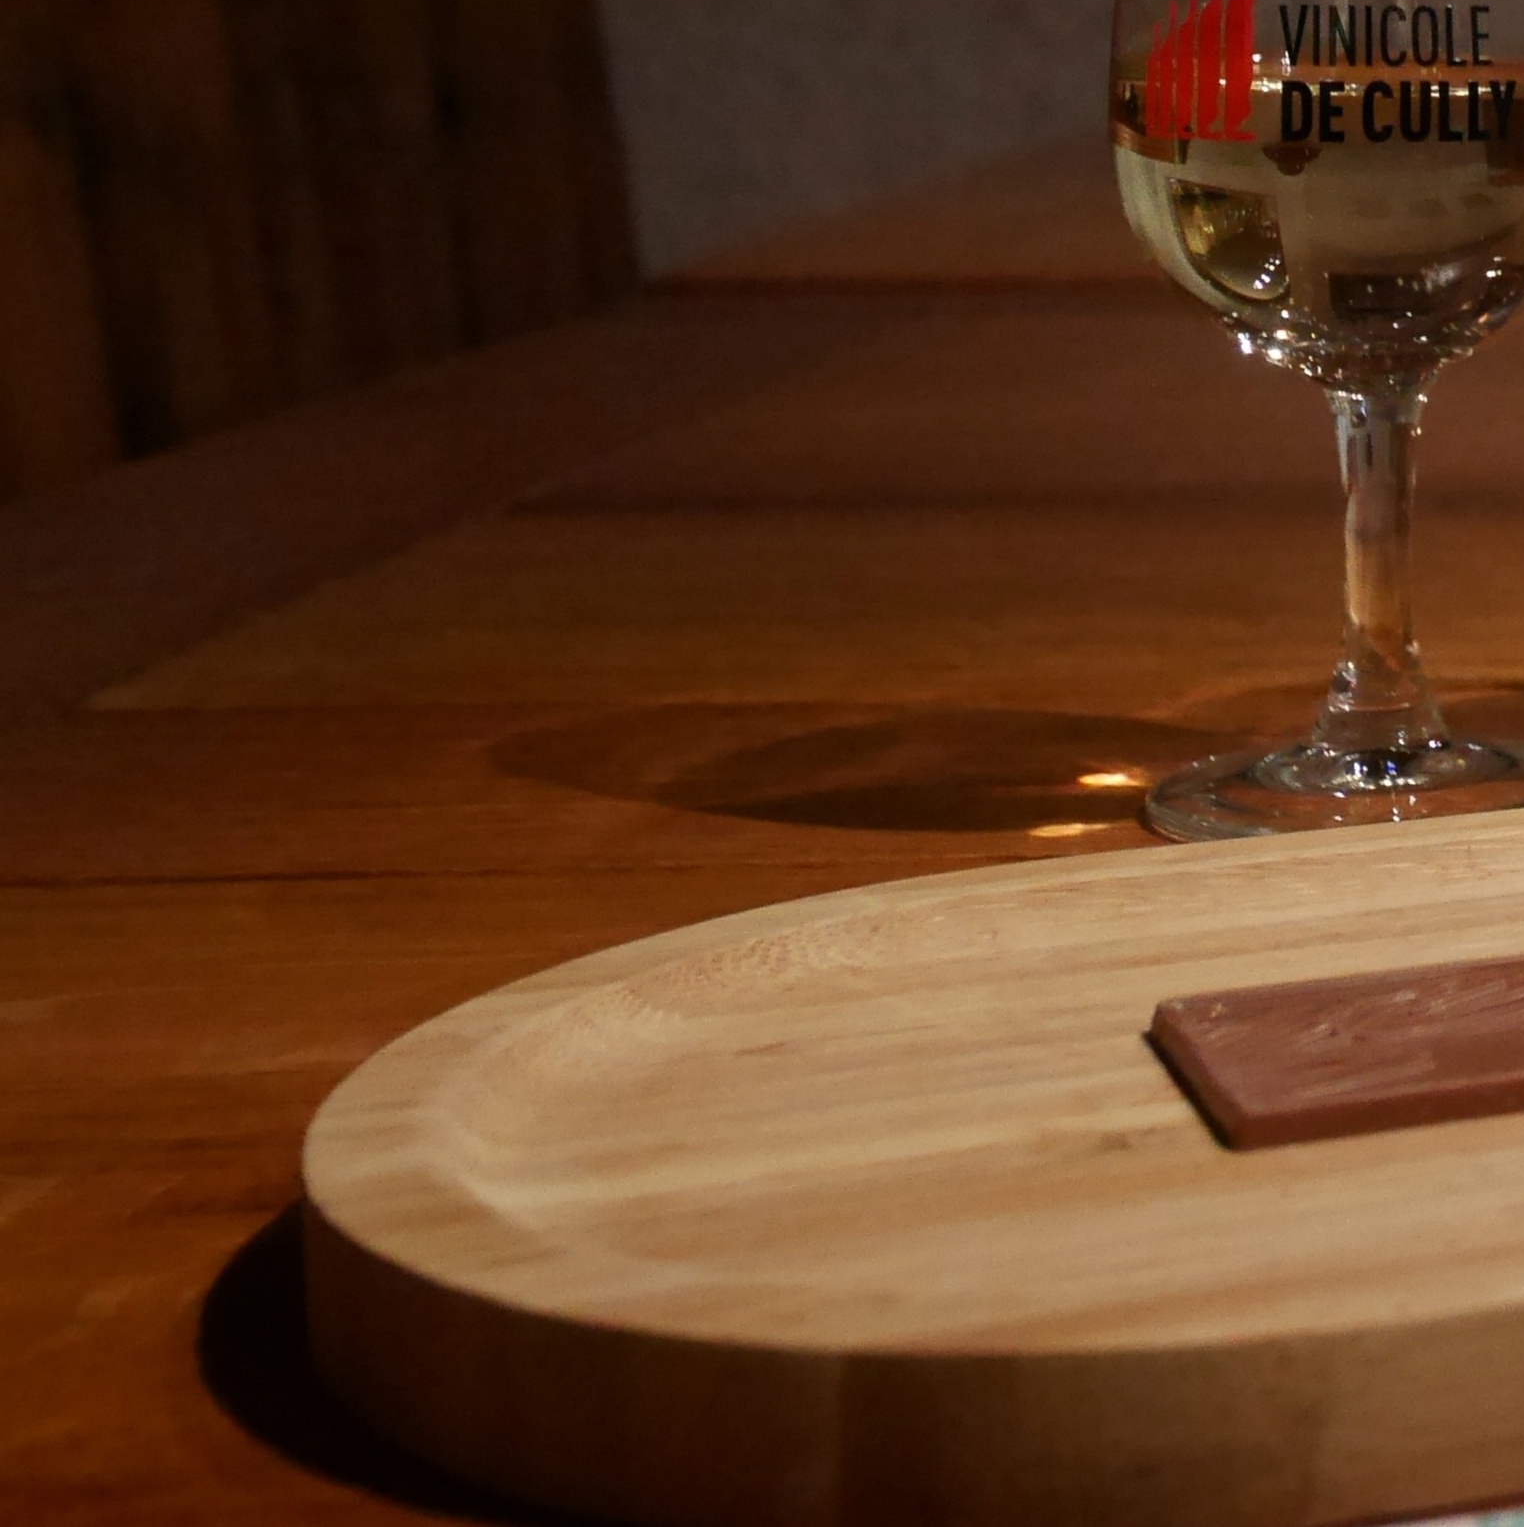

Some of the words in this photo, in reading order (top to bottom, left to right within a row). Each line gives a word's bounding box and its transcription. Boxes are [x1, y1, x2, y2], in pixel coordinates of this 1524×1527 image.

[1279, 4, 1494, 67] VINICOLE
[1280, 80, 1345, 144] DE
[1362, 79, 1517, 143] CULLY
